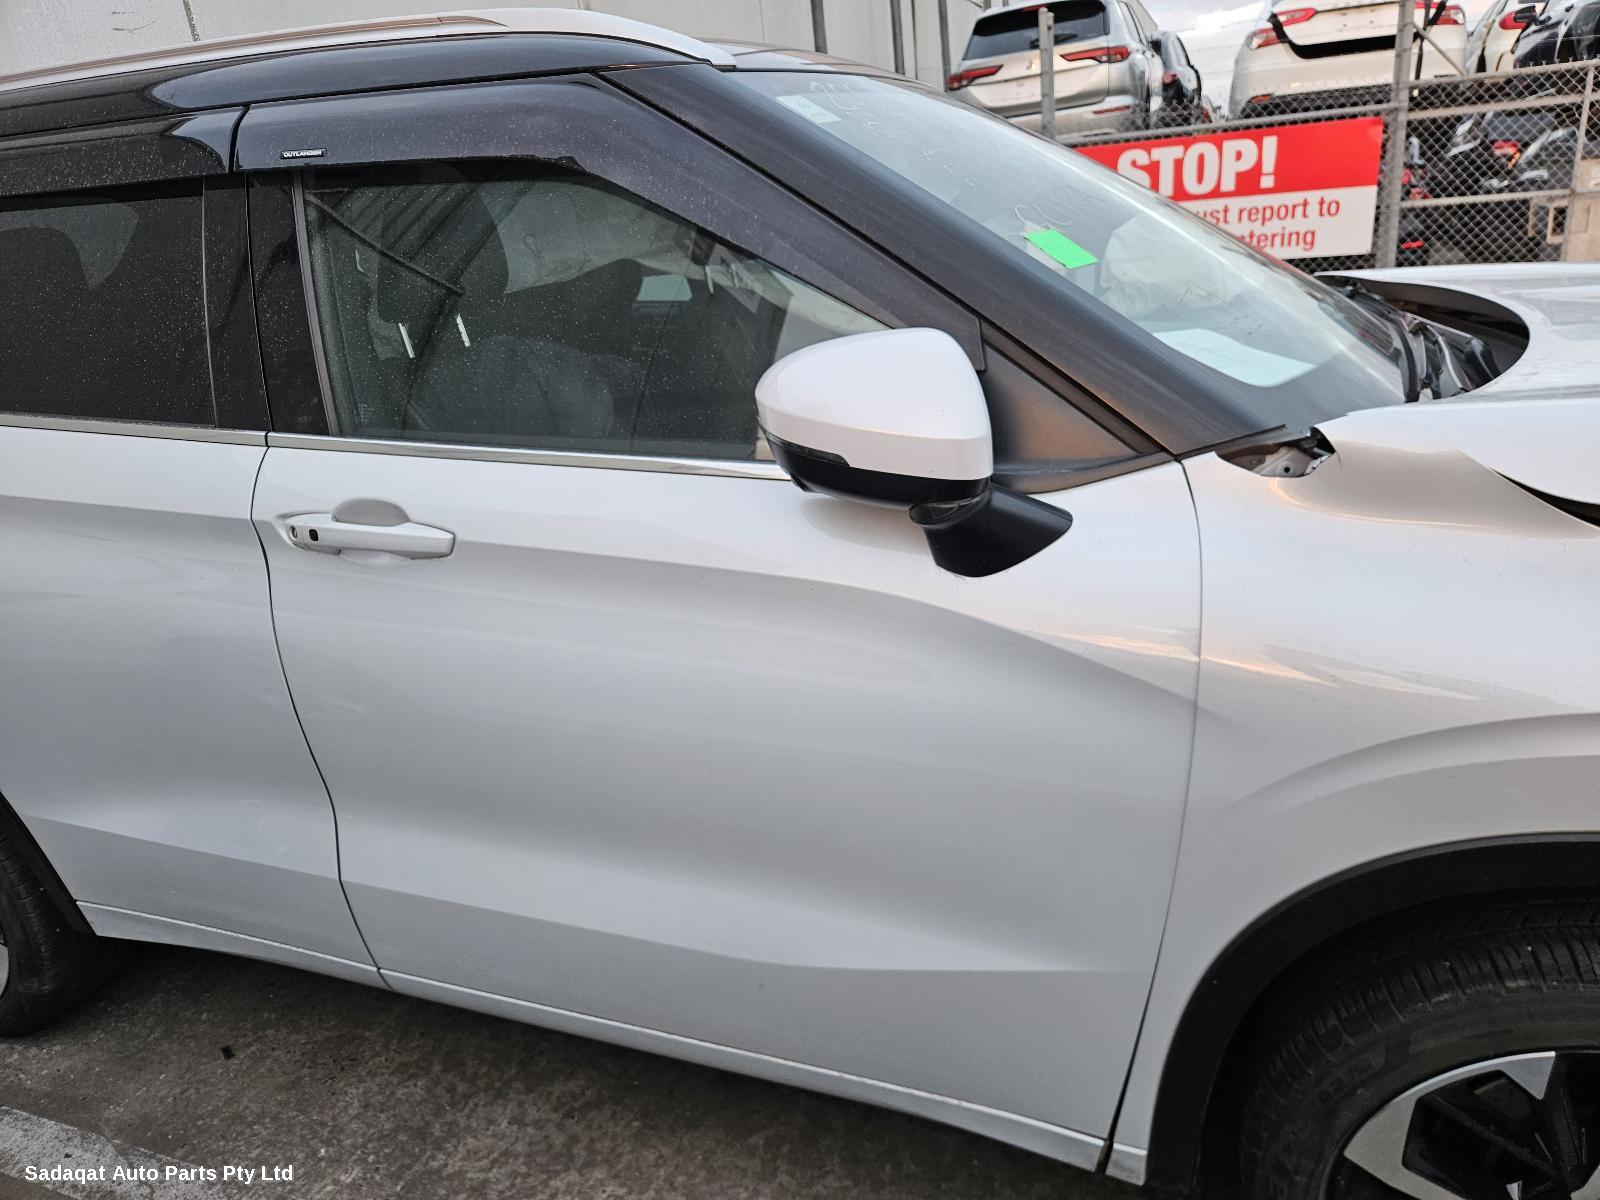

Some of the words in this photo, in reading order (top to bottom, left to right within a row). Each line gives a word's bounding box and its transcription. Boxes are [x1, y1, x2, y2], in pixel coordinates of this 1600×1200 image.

[1116, 135, 1279, 197] STOP!
[1237, 197, 1309, 226] report
[1318, 196, 1341, 218] to
[1237, 227, 1316, 251] tering
